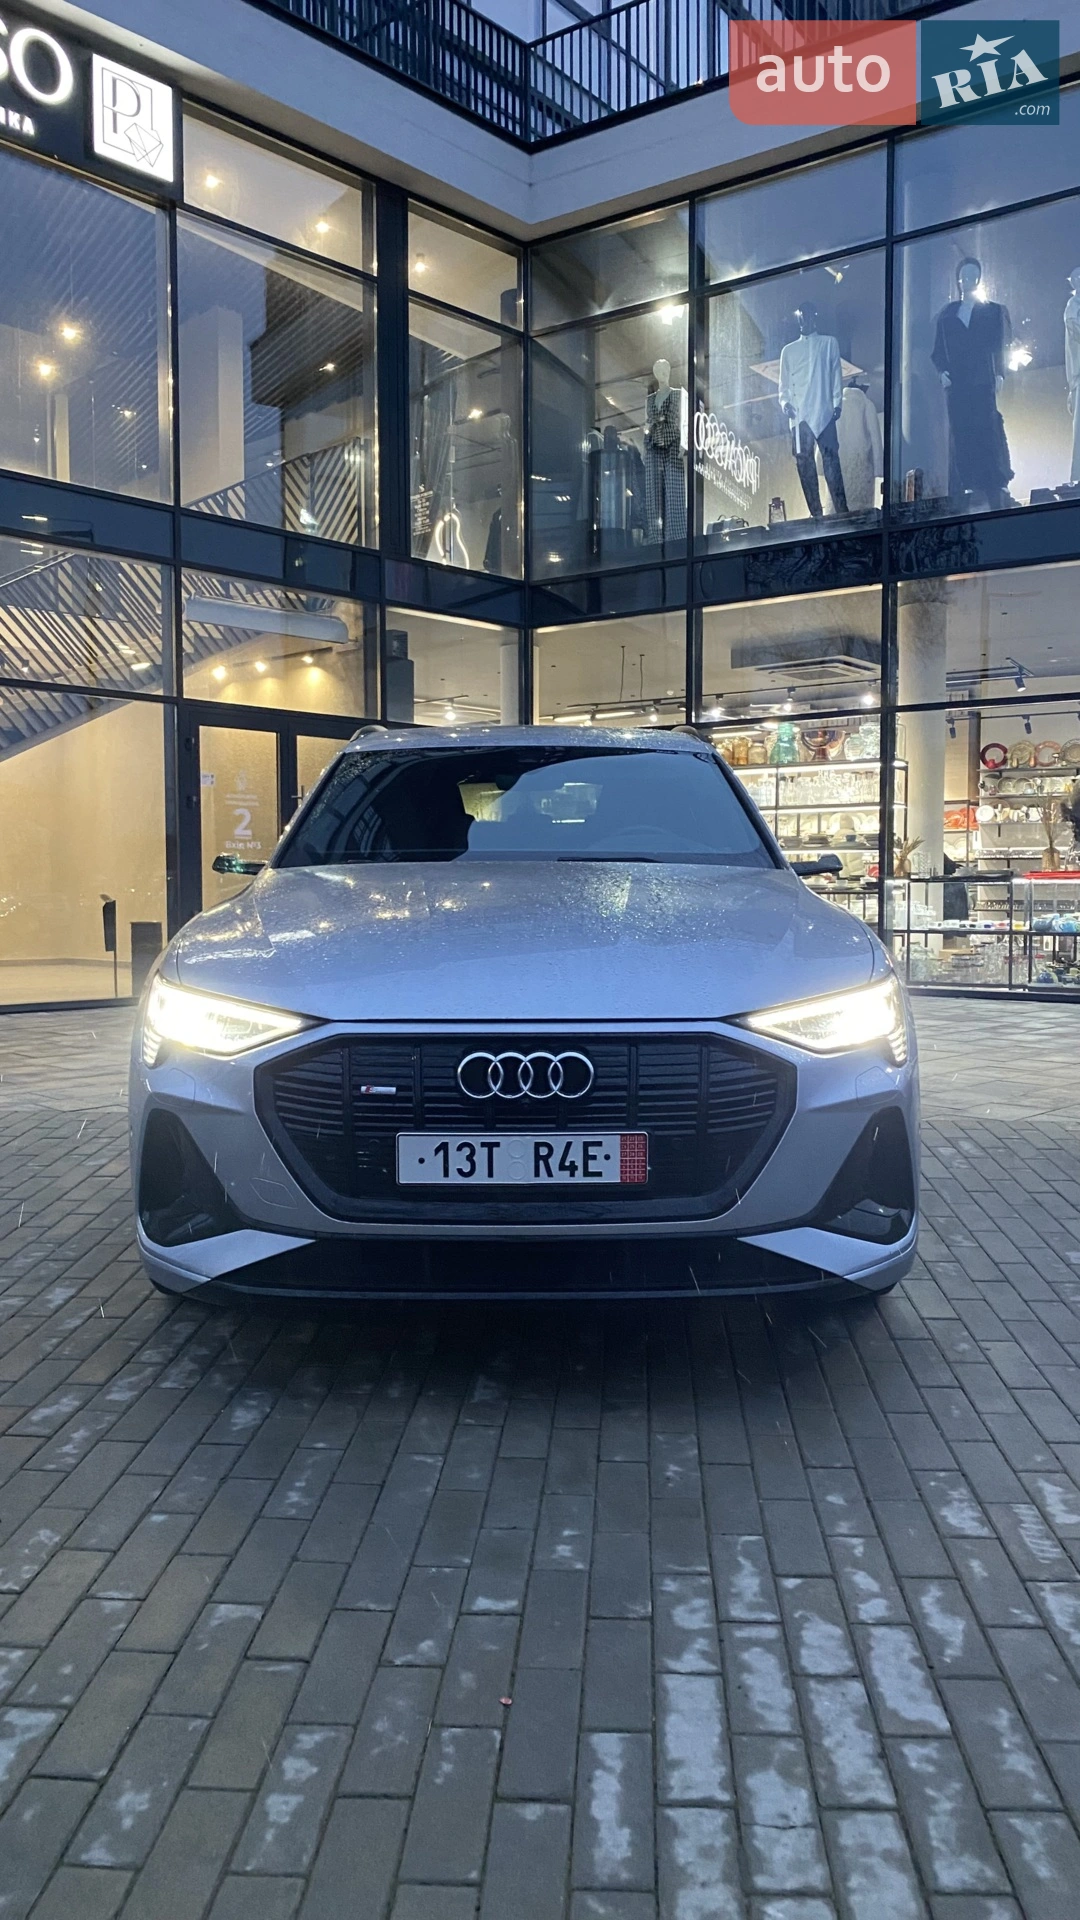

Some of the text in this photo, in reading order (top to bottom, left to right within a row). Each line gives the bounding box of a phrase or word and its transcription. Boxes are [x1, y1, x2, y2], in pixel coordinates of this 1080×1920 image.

[0, 18, 74, 106] O
[233, 808, 252, 837] 2
[434, 1141, 500, 1178] 13T
[533, 1141, 603, 1178] R4E
